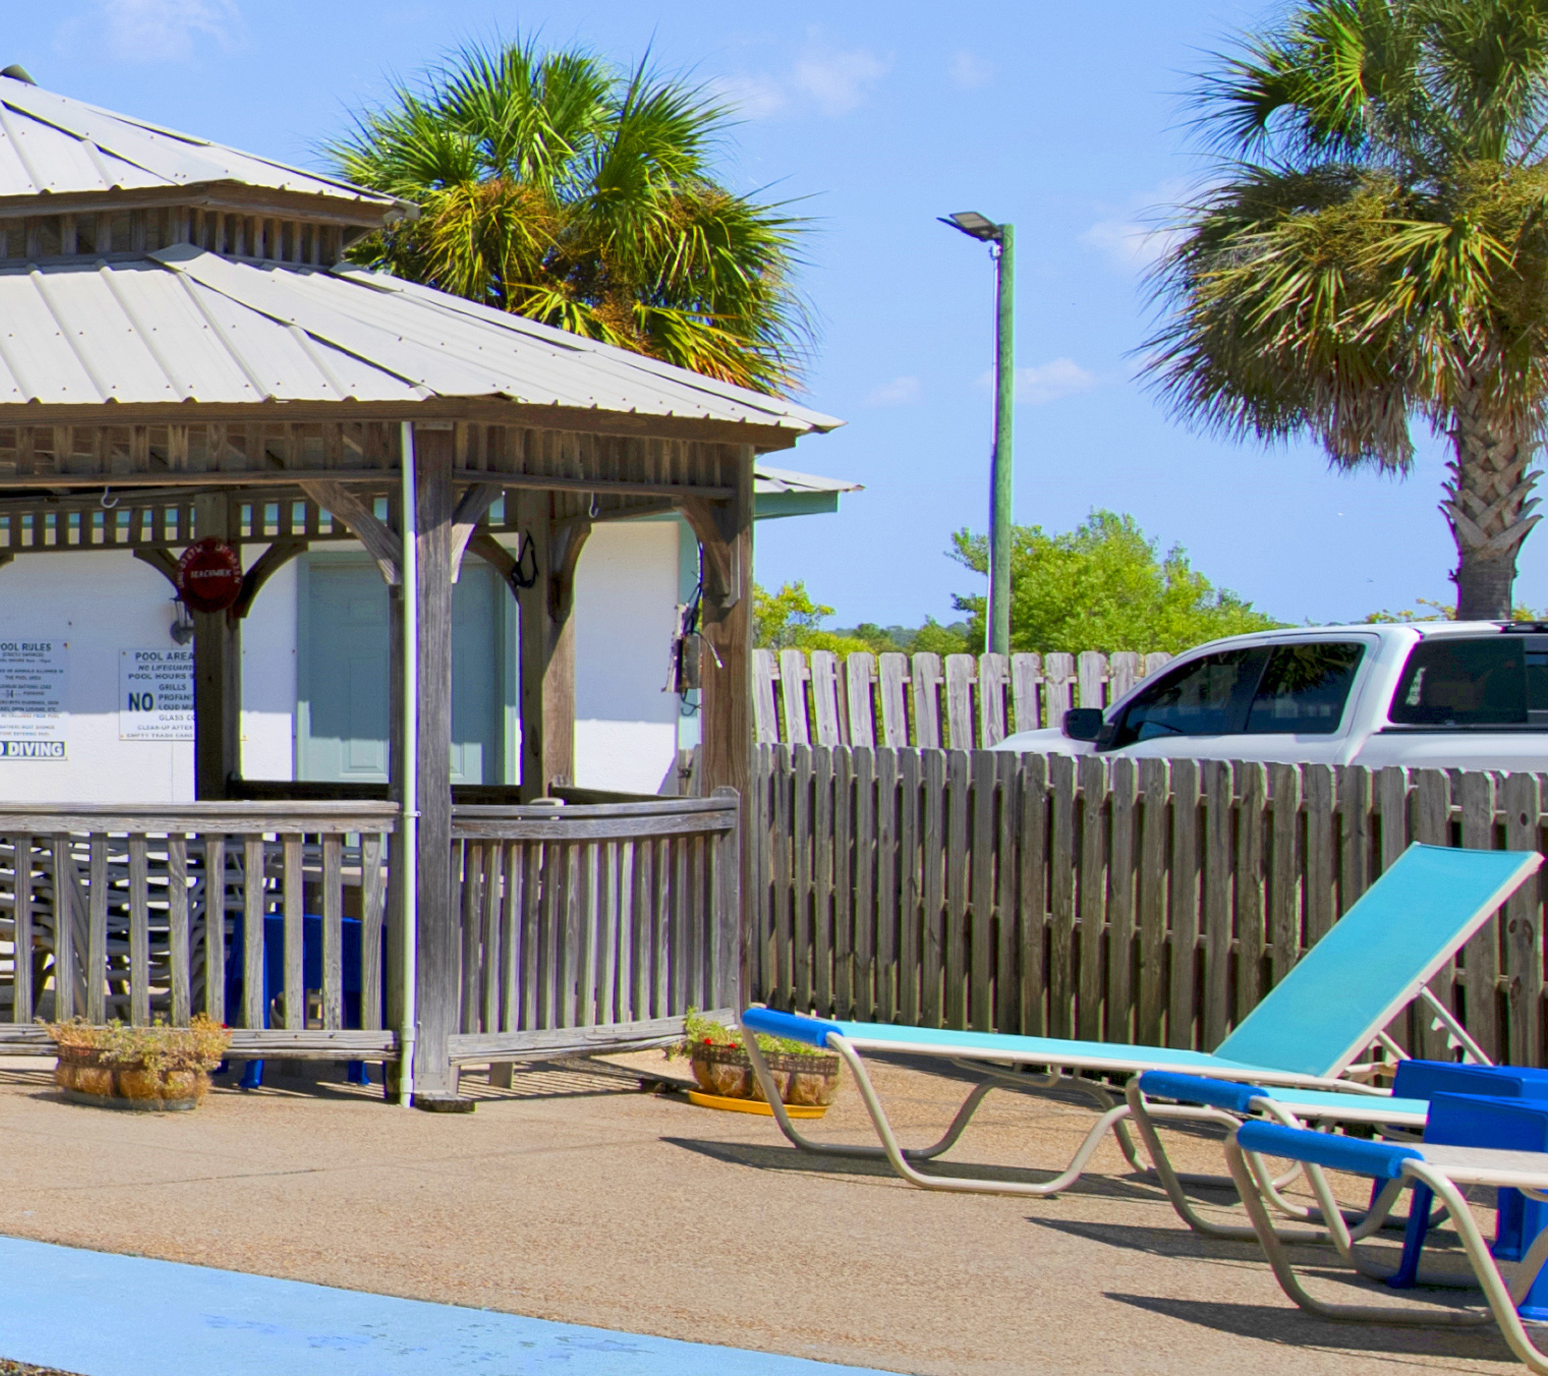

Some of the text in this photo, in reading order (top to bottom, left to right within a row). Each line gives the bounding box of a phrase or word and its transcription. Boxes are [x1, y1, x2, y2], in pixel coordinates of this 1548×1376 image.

[22, 642, 52, 652] RULES
[135, 652, 194, 661] POOL AREA
[159, 683, 187, 691] GRILLS
[128, 692, 154, 712] NO
[159, 714, 184, 722] GLASS
[8, 742, 64, 757] DIVING
